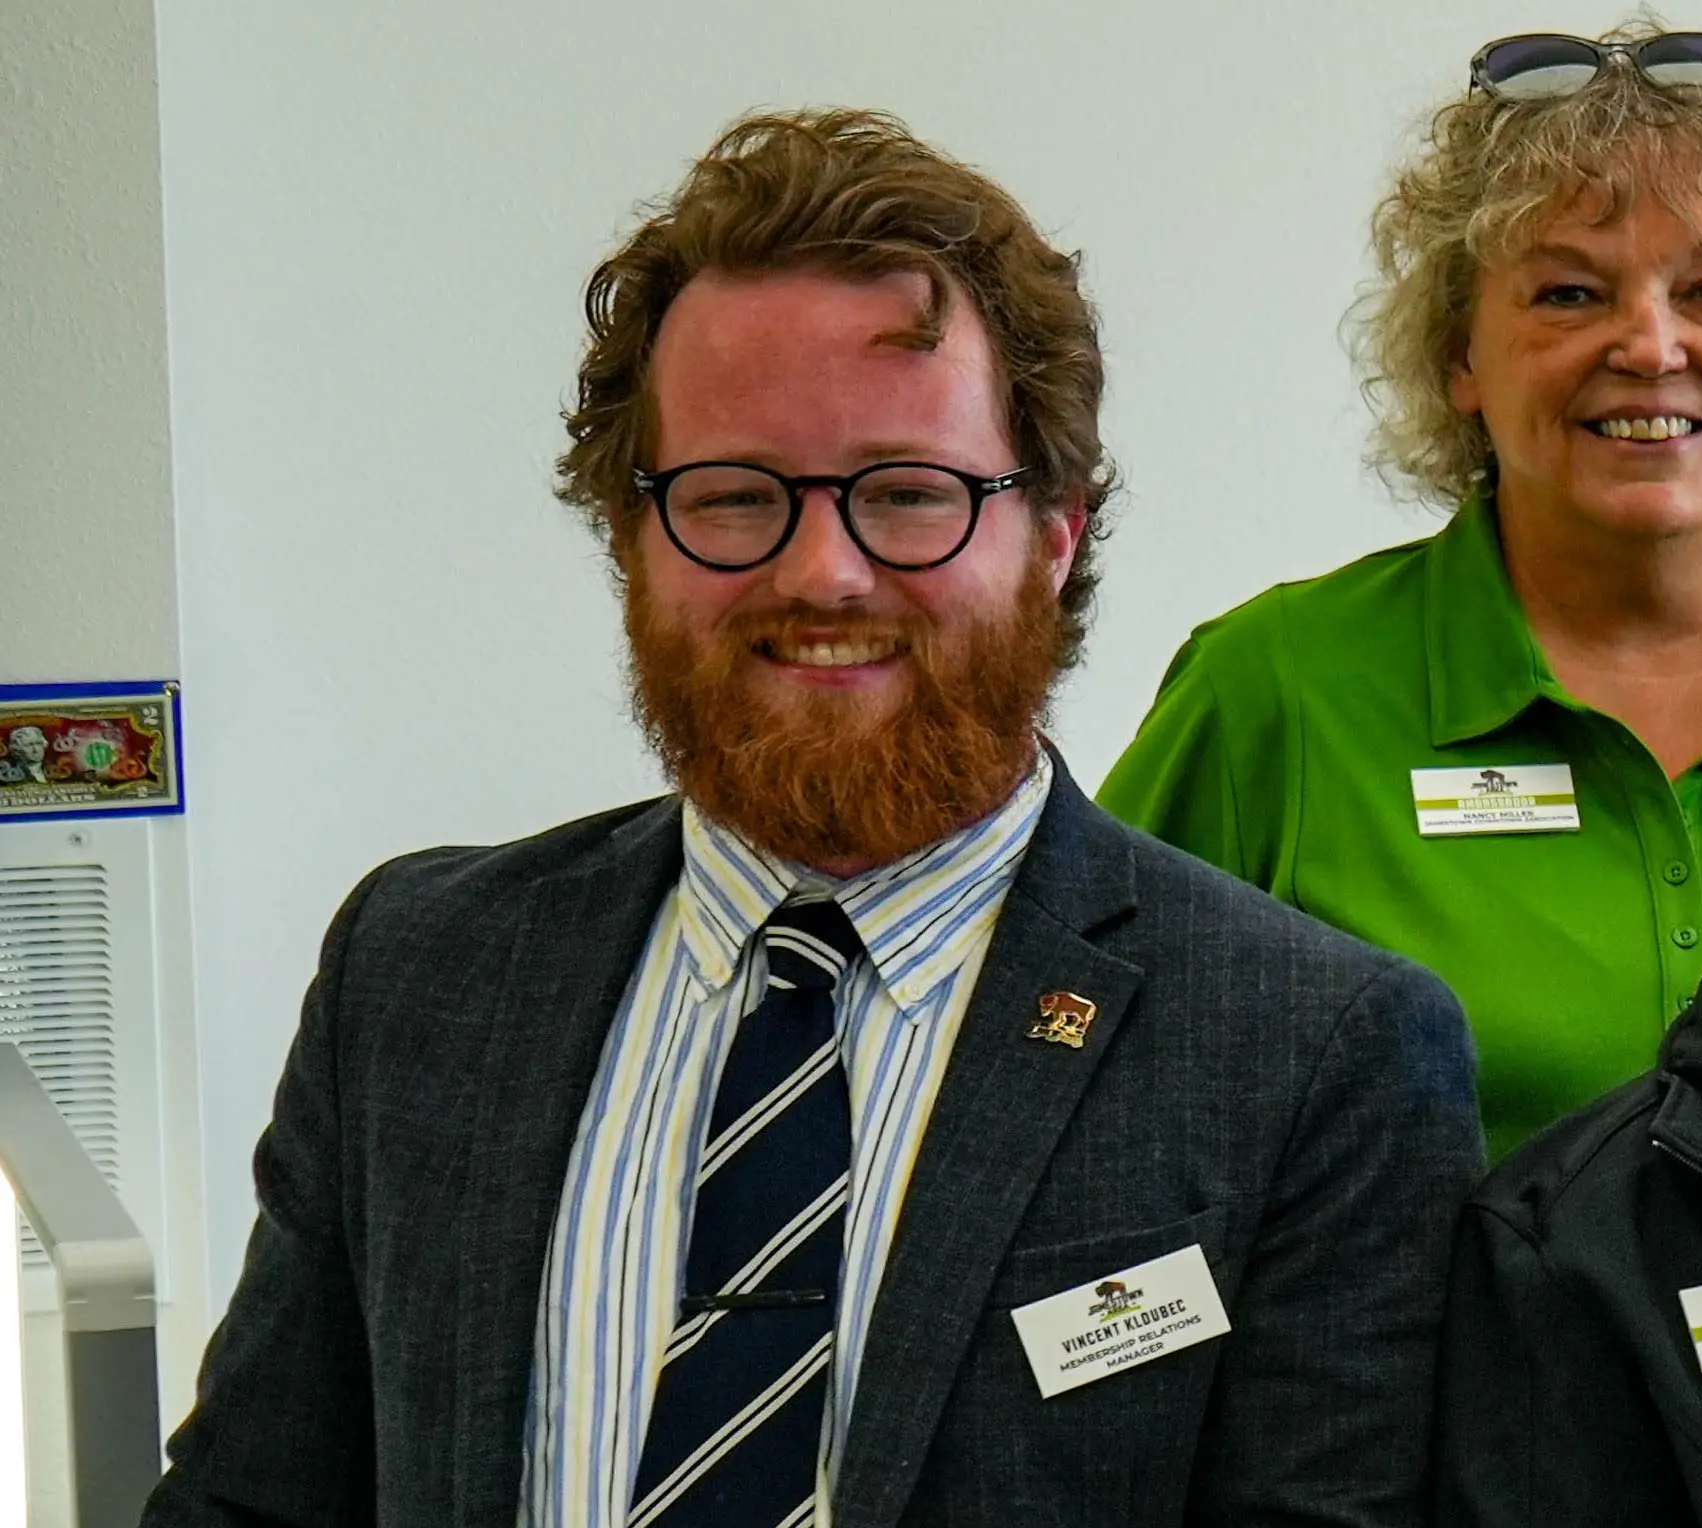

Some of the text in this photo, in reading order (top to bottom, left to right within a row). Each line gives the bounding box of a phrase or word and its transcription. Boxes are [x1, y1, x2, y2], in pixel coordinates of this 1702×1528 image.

[1059, 1314, 1201, 1372] MEMBERSHIP RELATIONS
[1062, 1299, 1187, 1354] VINCENT KLOUBEC
[1106, 1342, 1164, 1369] MANAGER
